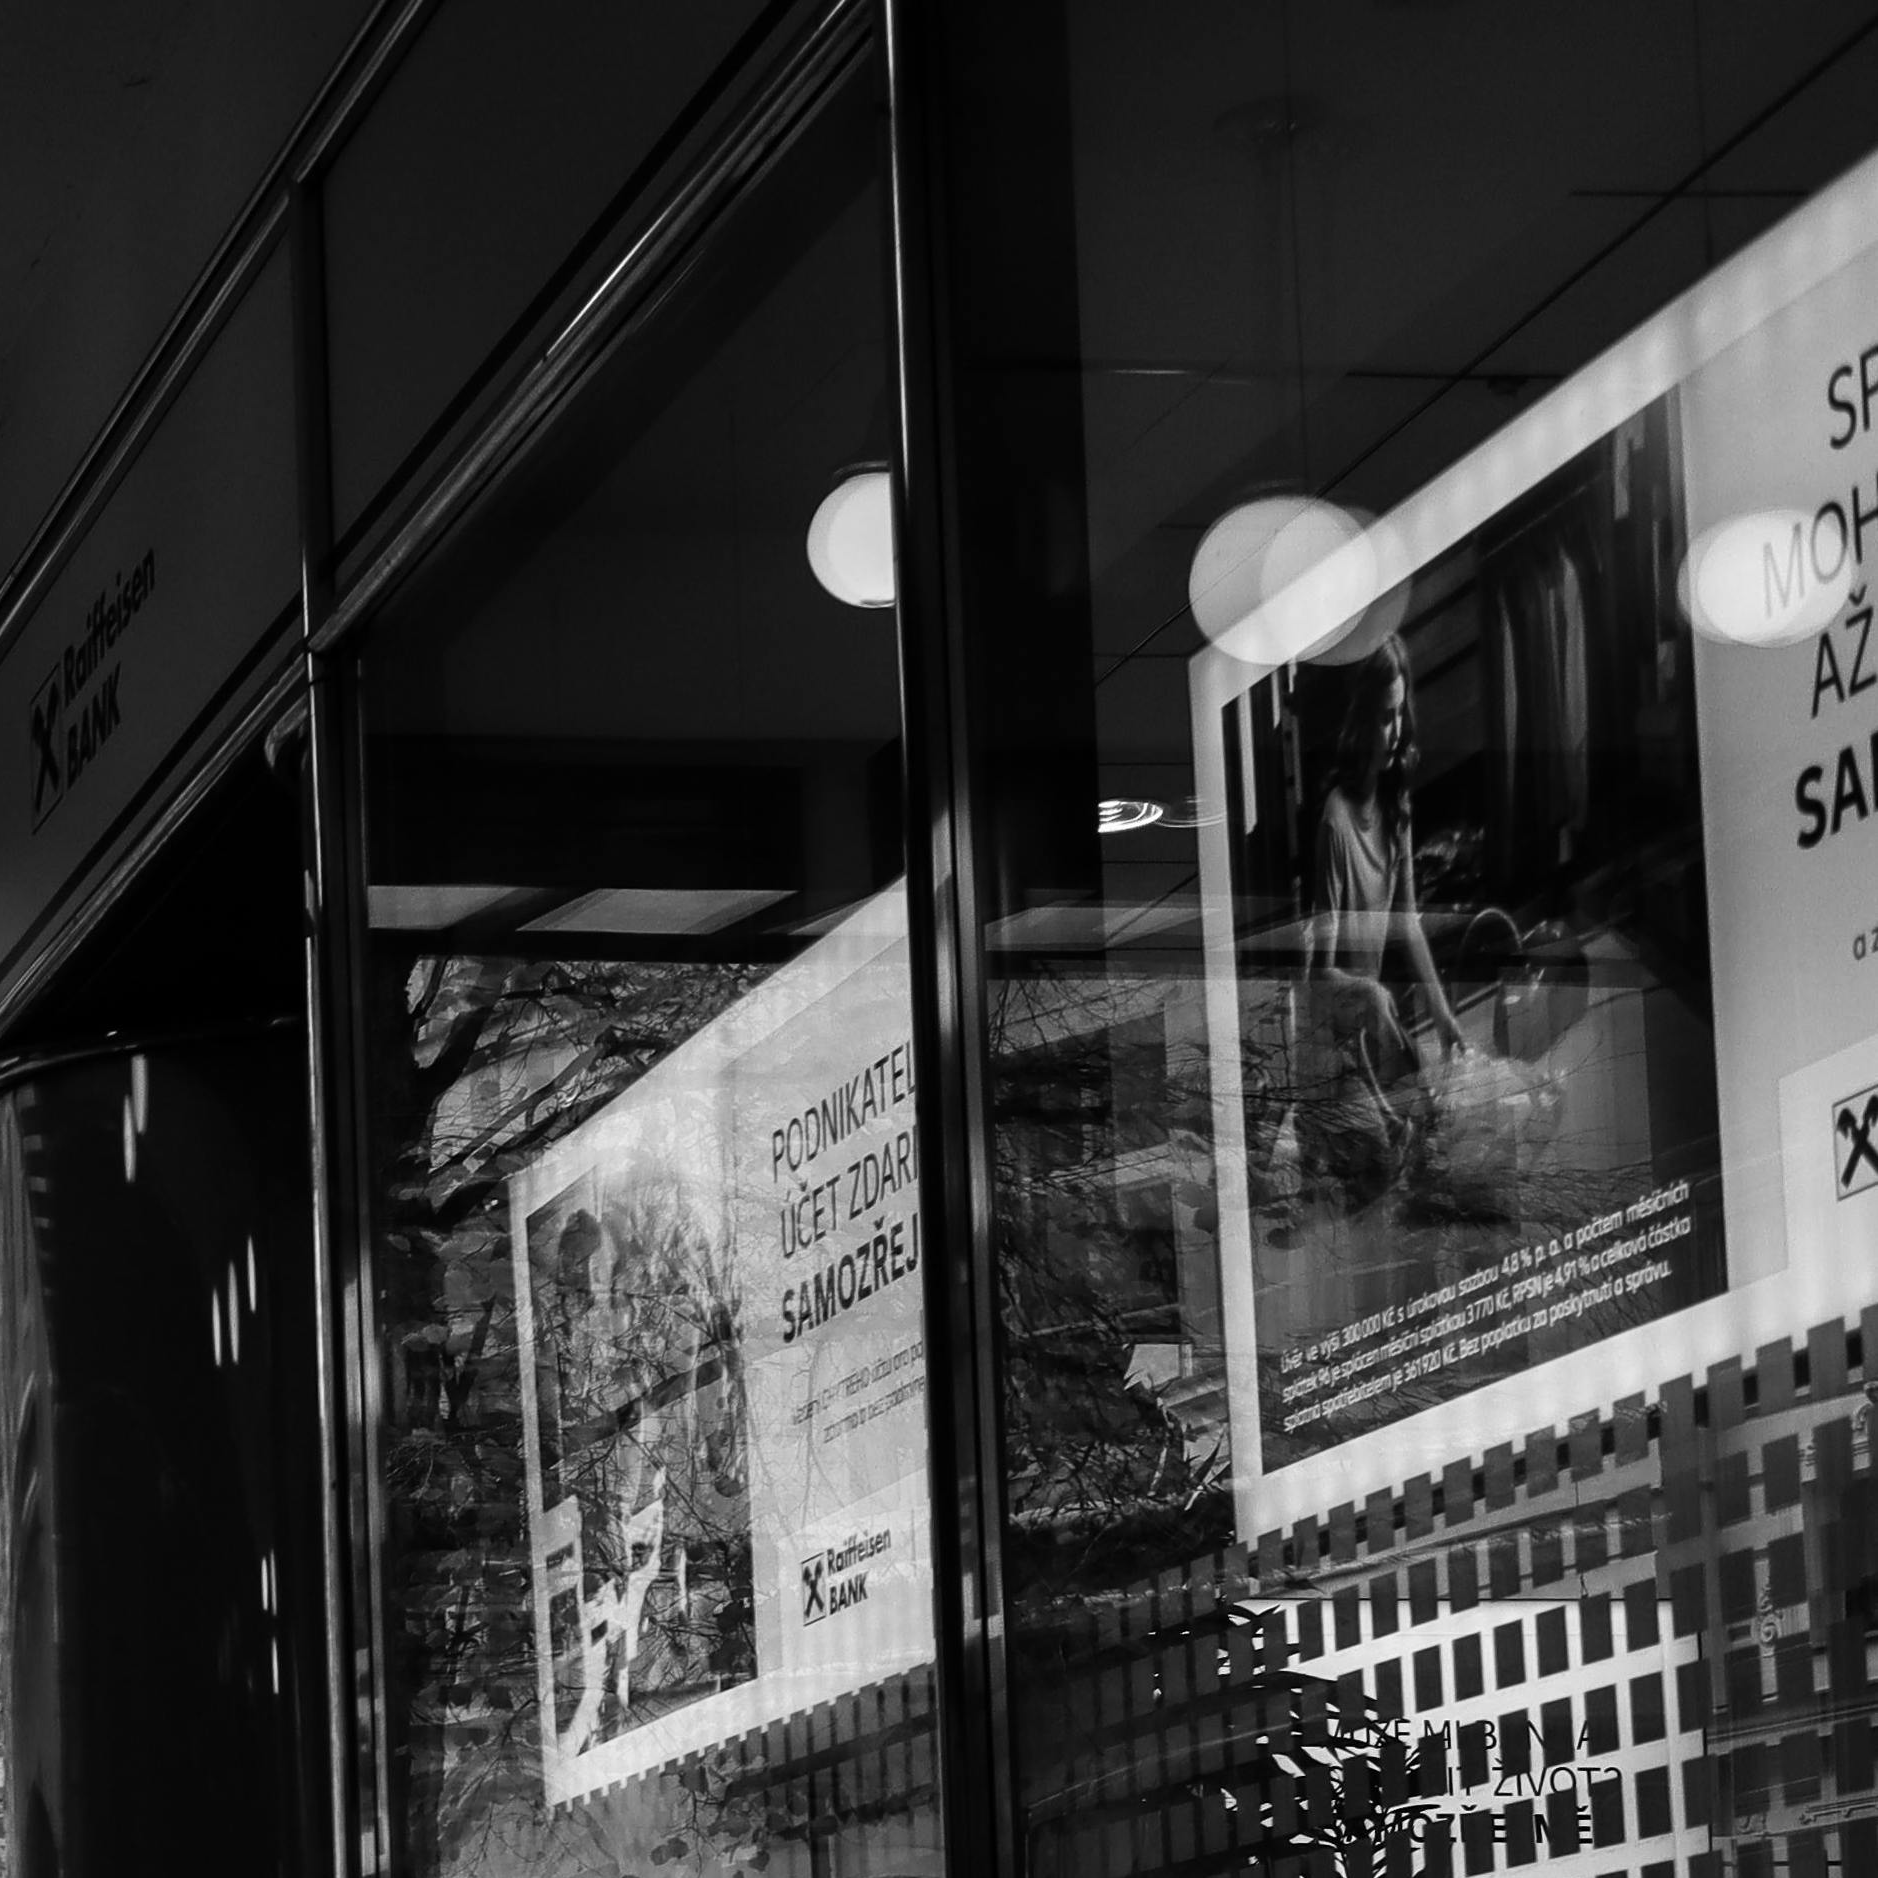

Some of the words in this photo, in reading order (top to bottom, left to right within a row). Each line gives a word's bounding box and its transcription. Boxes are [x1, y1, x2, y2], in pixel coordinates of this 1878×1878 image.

[63, 548, 155, 707] Raiffeisen
[1811, 585, 1877, 719] AŽ
[67, 662, 120, 790] BANK
[781, 1175, 841, 1260] ÚČET
[1397, 1306, 1405, 1324] s
[1563, 1232, 1574, 1251] a
[1575, 1210, 1623, 1250] počtem
[782, 1212, 918, 1344] SAMOZŘEJ
[1613, 1277, 1624, 1296] a
[827, 1528, 892, 1577] Raiffeisen
[829, 1569, 869, 1616] BANK
